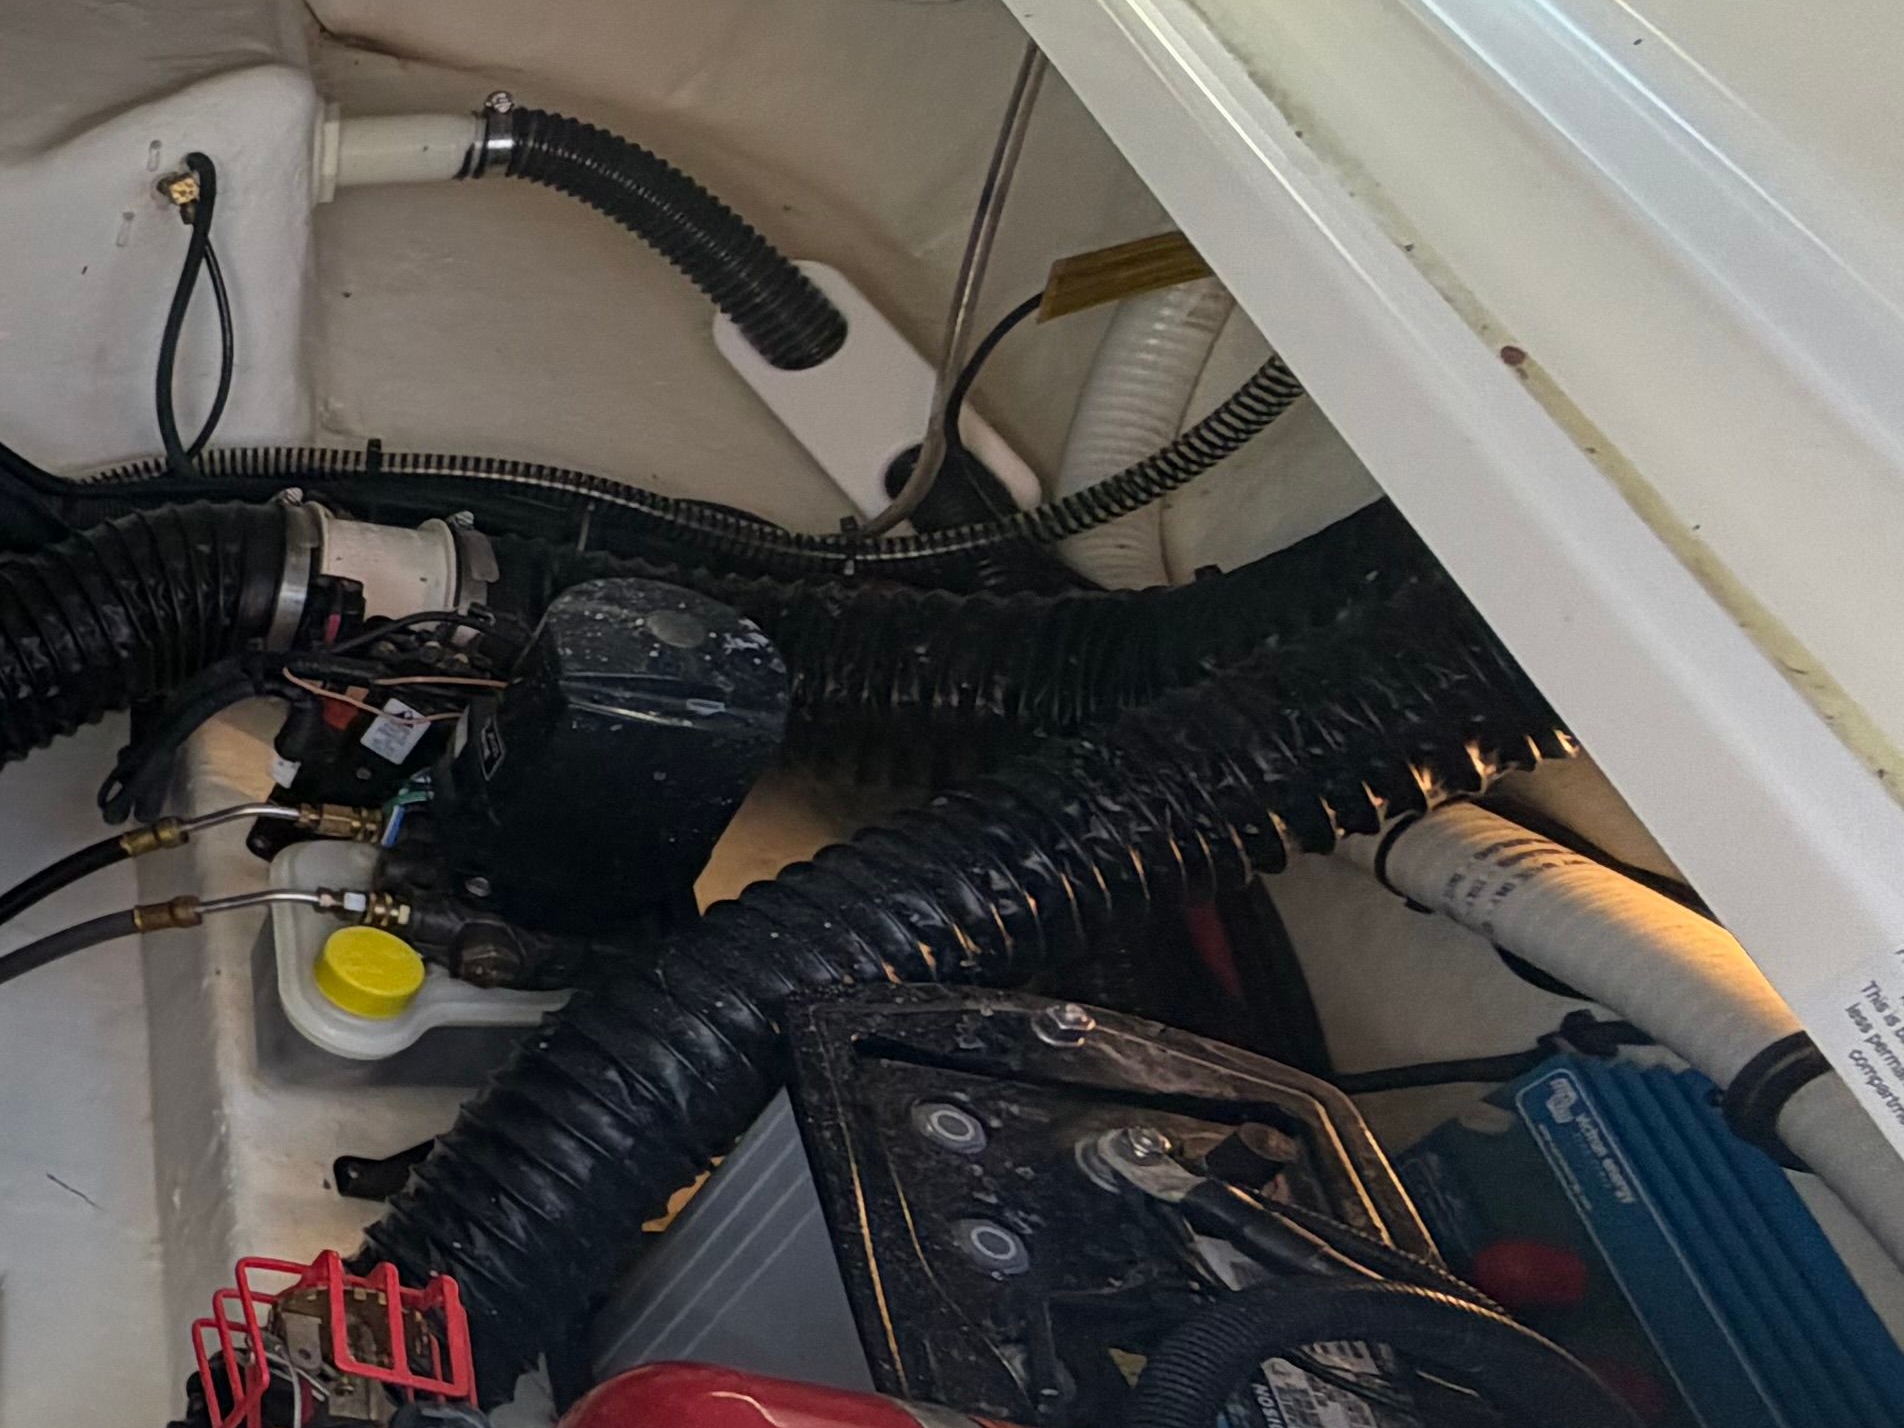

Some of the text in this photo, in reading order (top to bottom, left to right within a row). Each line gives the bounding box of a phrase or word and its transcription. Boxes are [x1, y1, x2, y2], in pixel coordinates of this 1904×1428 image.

[1861, 980, 1889, 1012] This
[1845, 1003, 1873, 1033] less
[1576, 1113, 1608, 1157] victron
